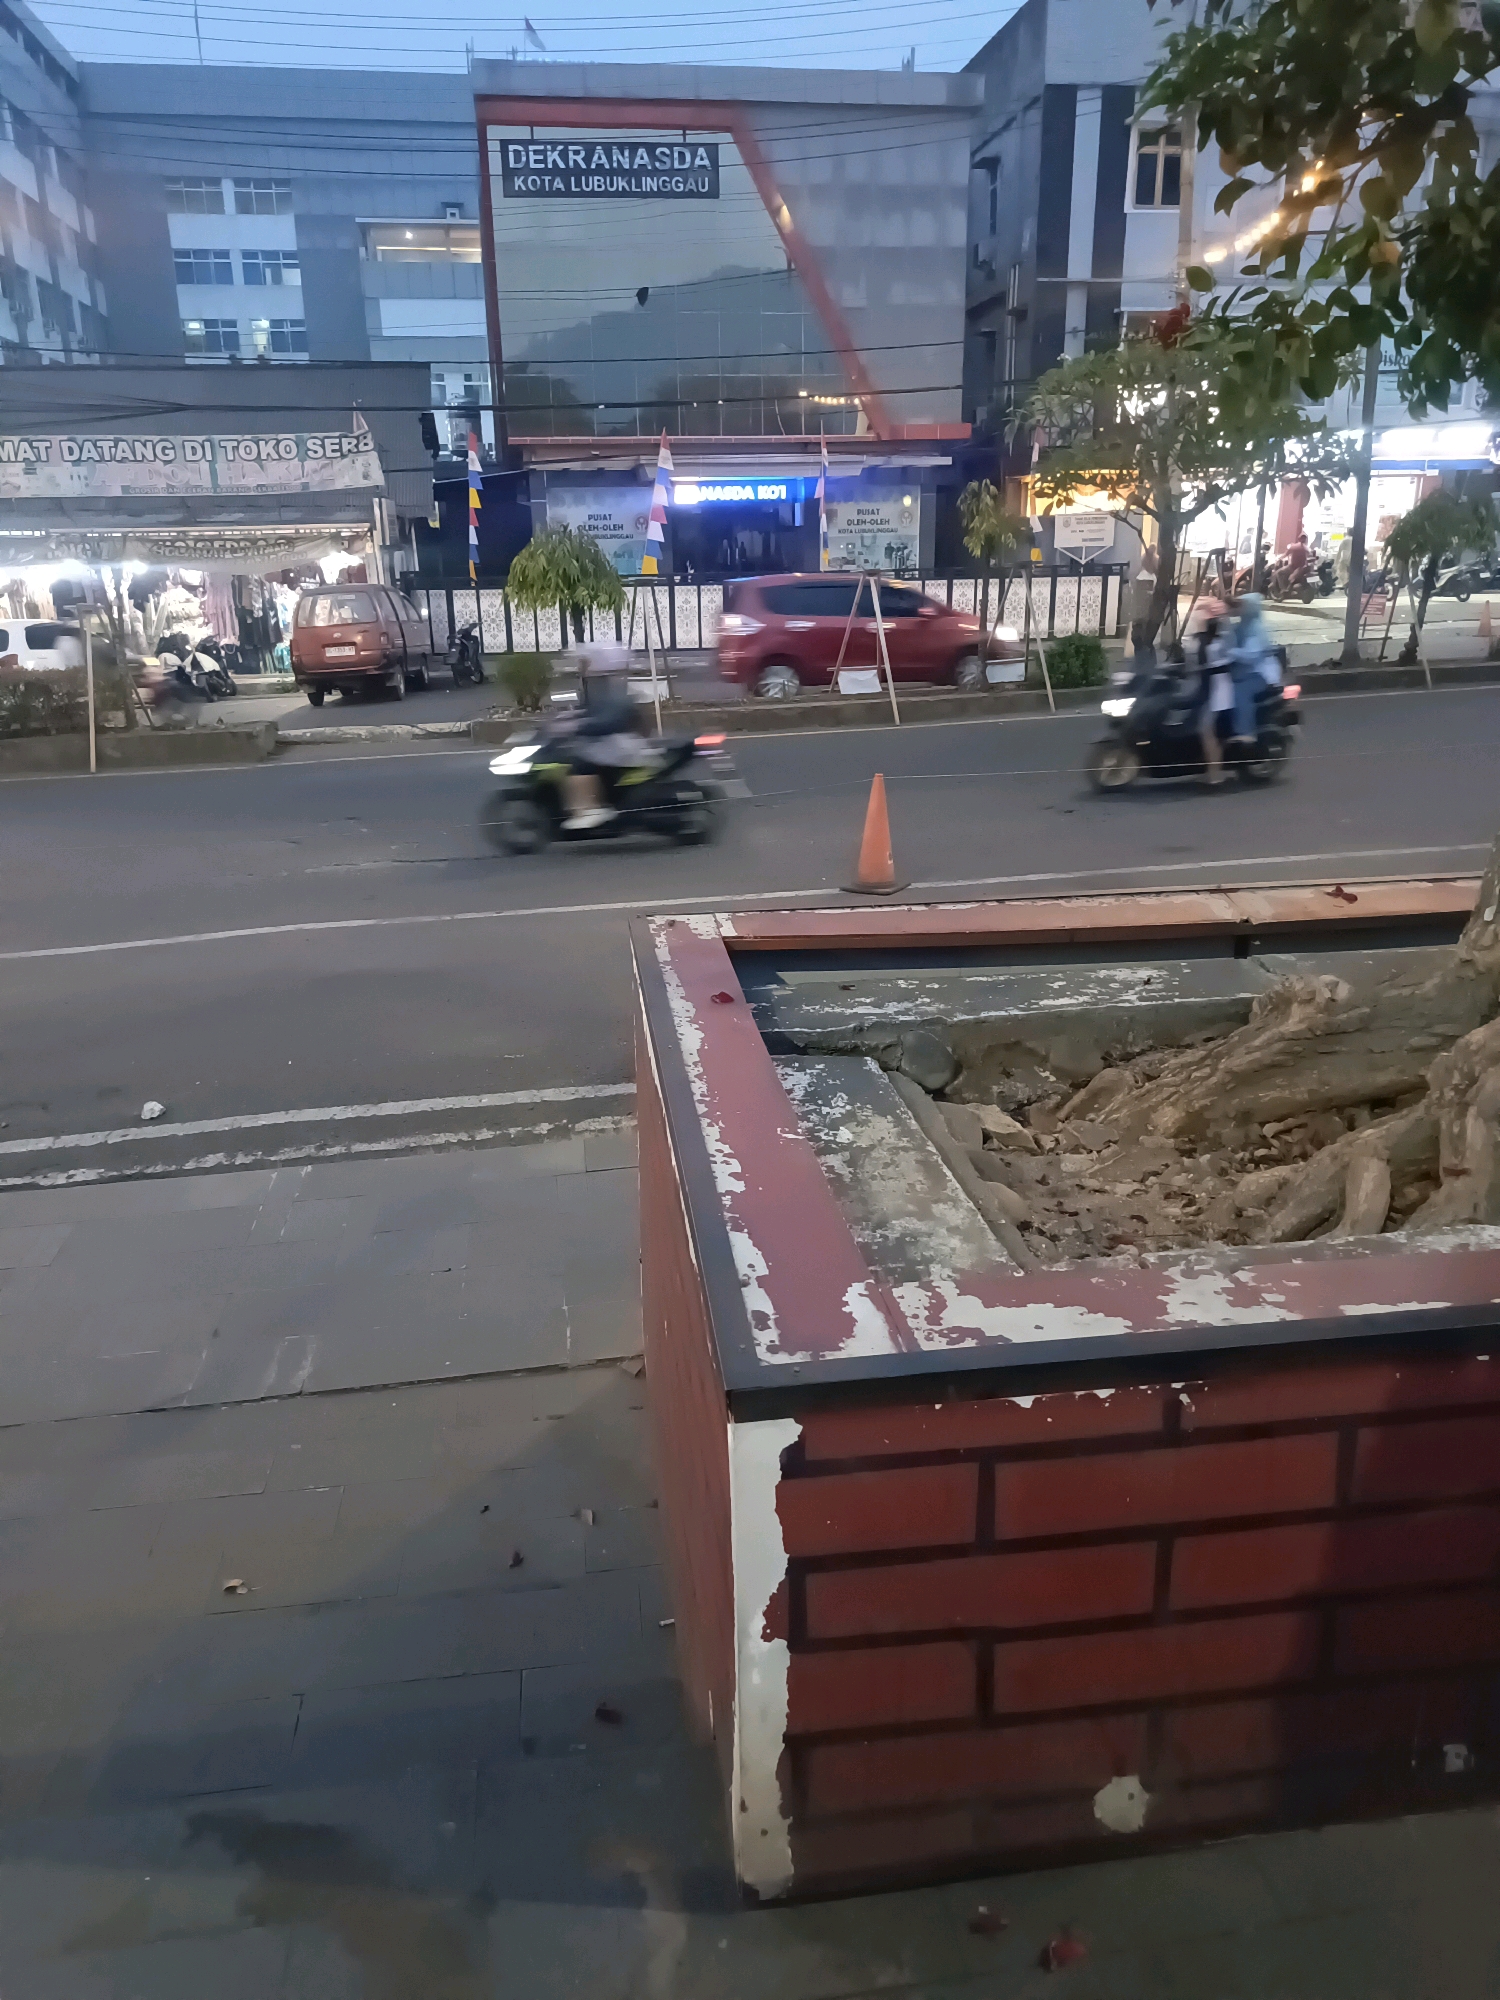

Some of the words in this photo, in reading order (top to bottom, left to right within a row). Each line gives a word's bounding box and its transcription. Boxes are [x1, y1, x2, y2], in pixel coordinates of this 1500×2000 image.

[507, 144, 712, 171] DEKRANASDA
[514, 176, 566, 191] KOTA
[571, 176, 709, 193] LUBUKLINGGAU
[59, 439, 176, 463] DATANG
[184, 439, 213, 462] DI
[220, 437, 298, 462] TOKO
[129, 487, 160, 495] GROSIR
[162, 487, 180, 495] DAN
[856, 508, 881, 516] PUSAT
[587, 513, 613, 521] PUSAT
[846, 518, 891, 527] OLEH-OLEH
